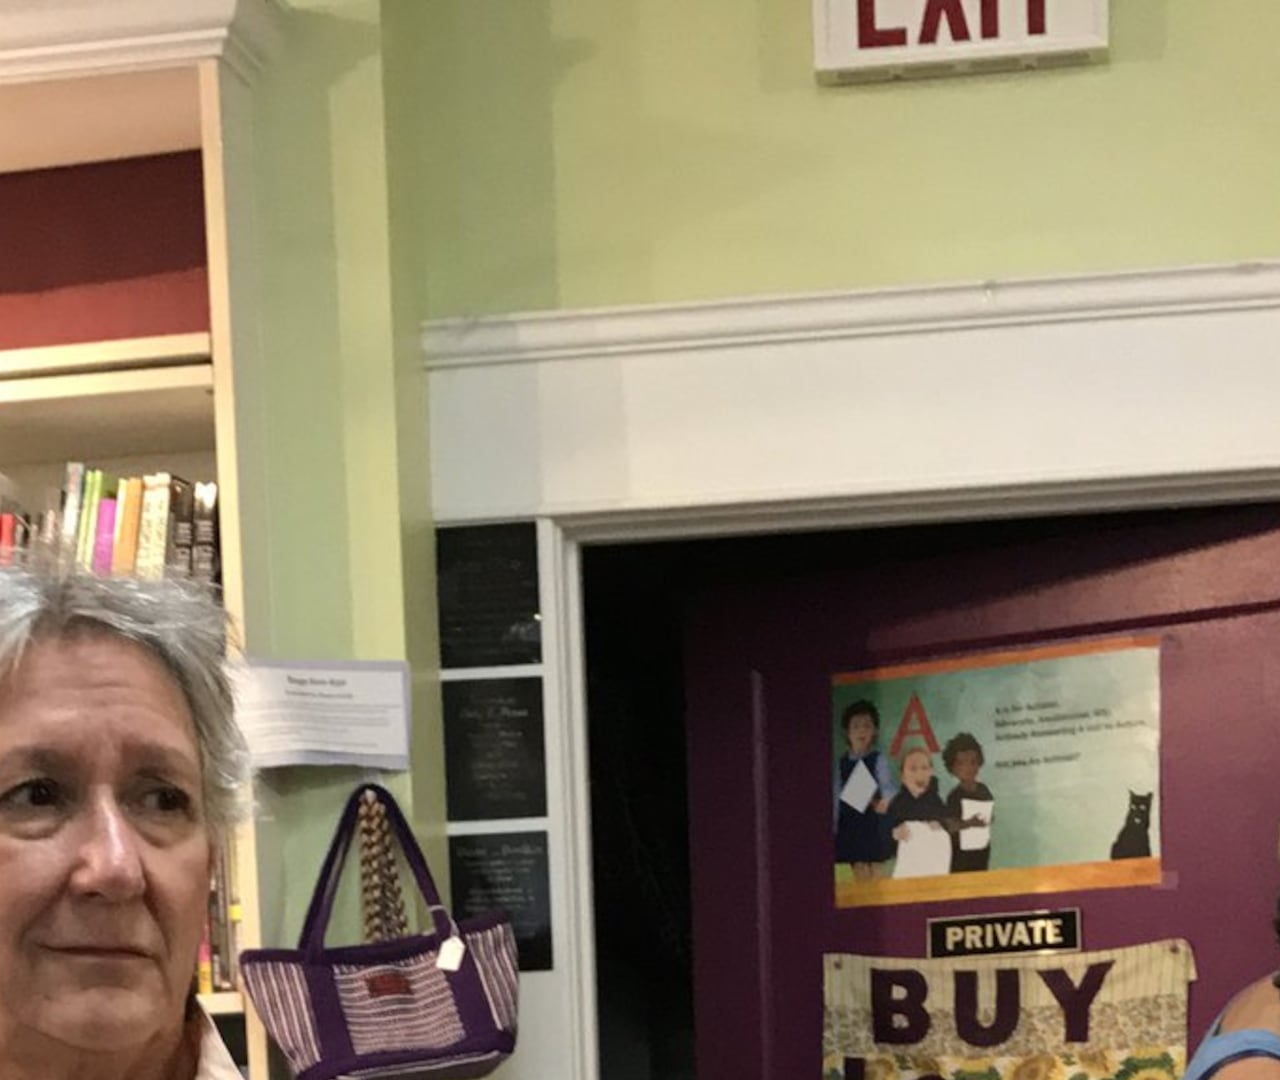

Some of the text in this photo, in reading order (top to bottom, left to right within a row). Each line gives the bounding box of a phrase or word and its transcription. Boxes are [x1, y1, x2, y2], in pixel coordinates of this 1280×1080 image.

[890, 690, 940, 758] A
[945, 918, 1063, 950] PRIVATE
[870, 959, 1116, 1047] BUY
